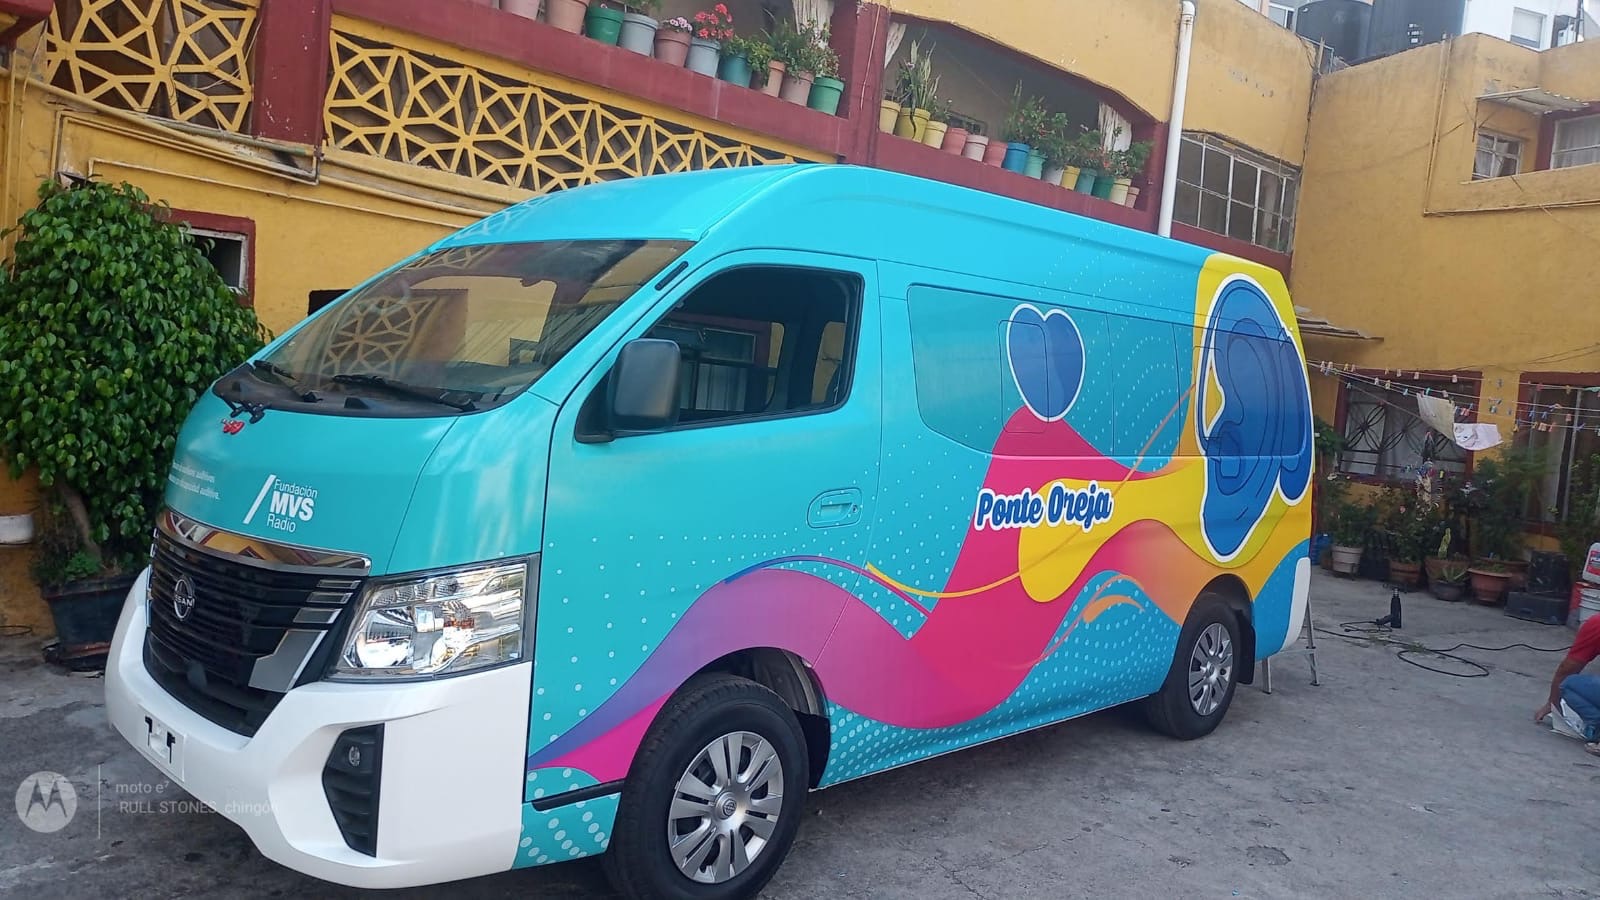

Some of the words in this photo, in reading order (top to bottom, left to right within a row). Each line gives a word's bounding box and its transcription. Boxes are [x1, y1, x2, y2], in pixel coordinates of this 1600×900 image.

[273, 479, 318, 499] Fundación
[269, 490, 315, 522] MVS
[975, 489, 1044, 528] Ponte
[1046, 482, 1113, 531] Oreja
[266, 513, 296, 533] Radio
